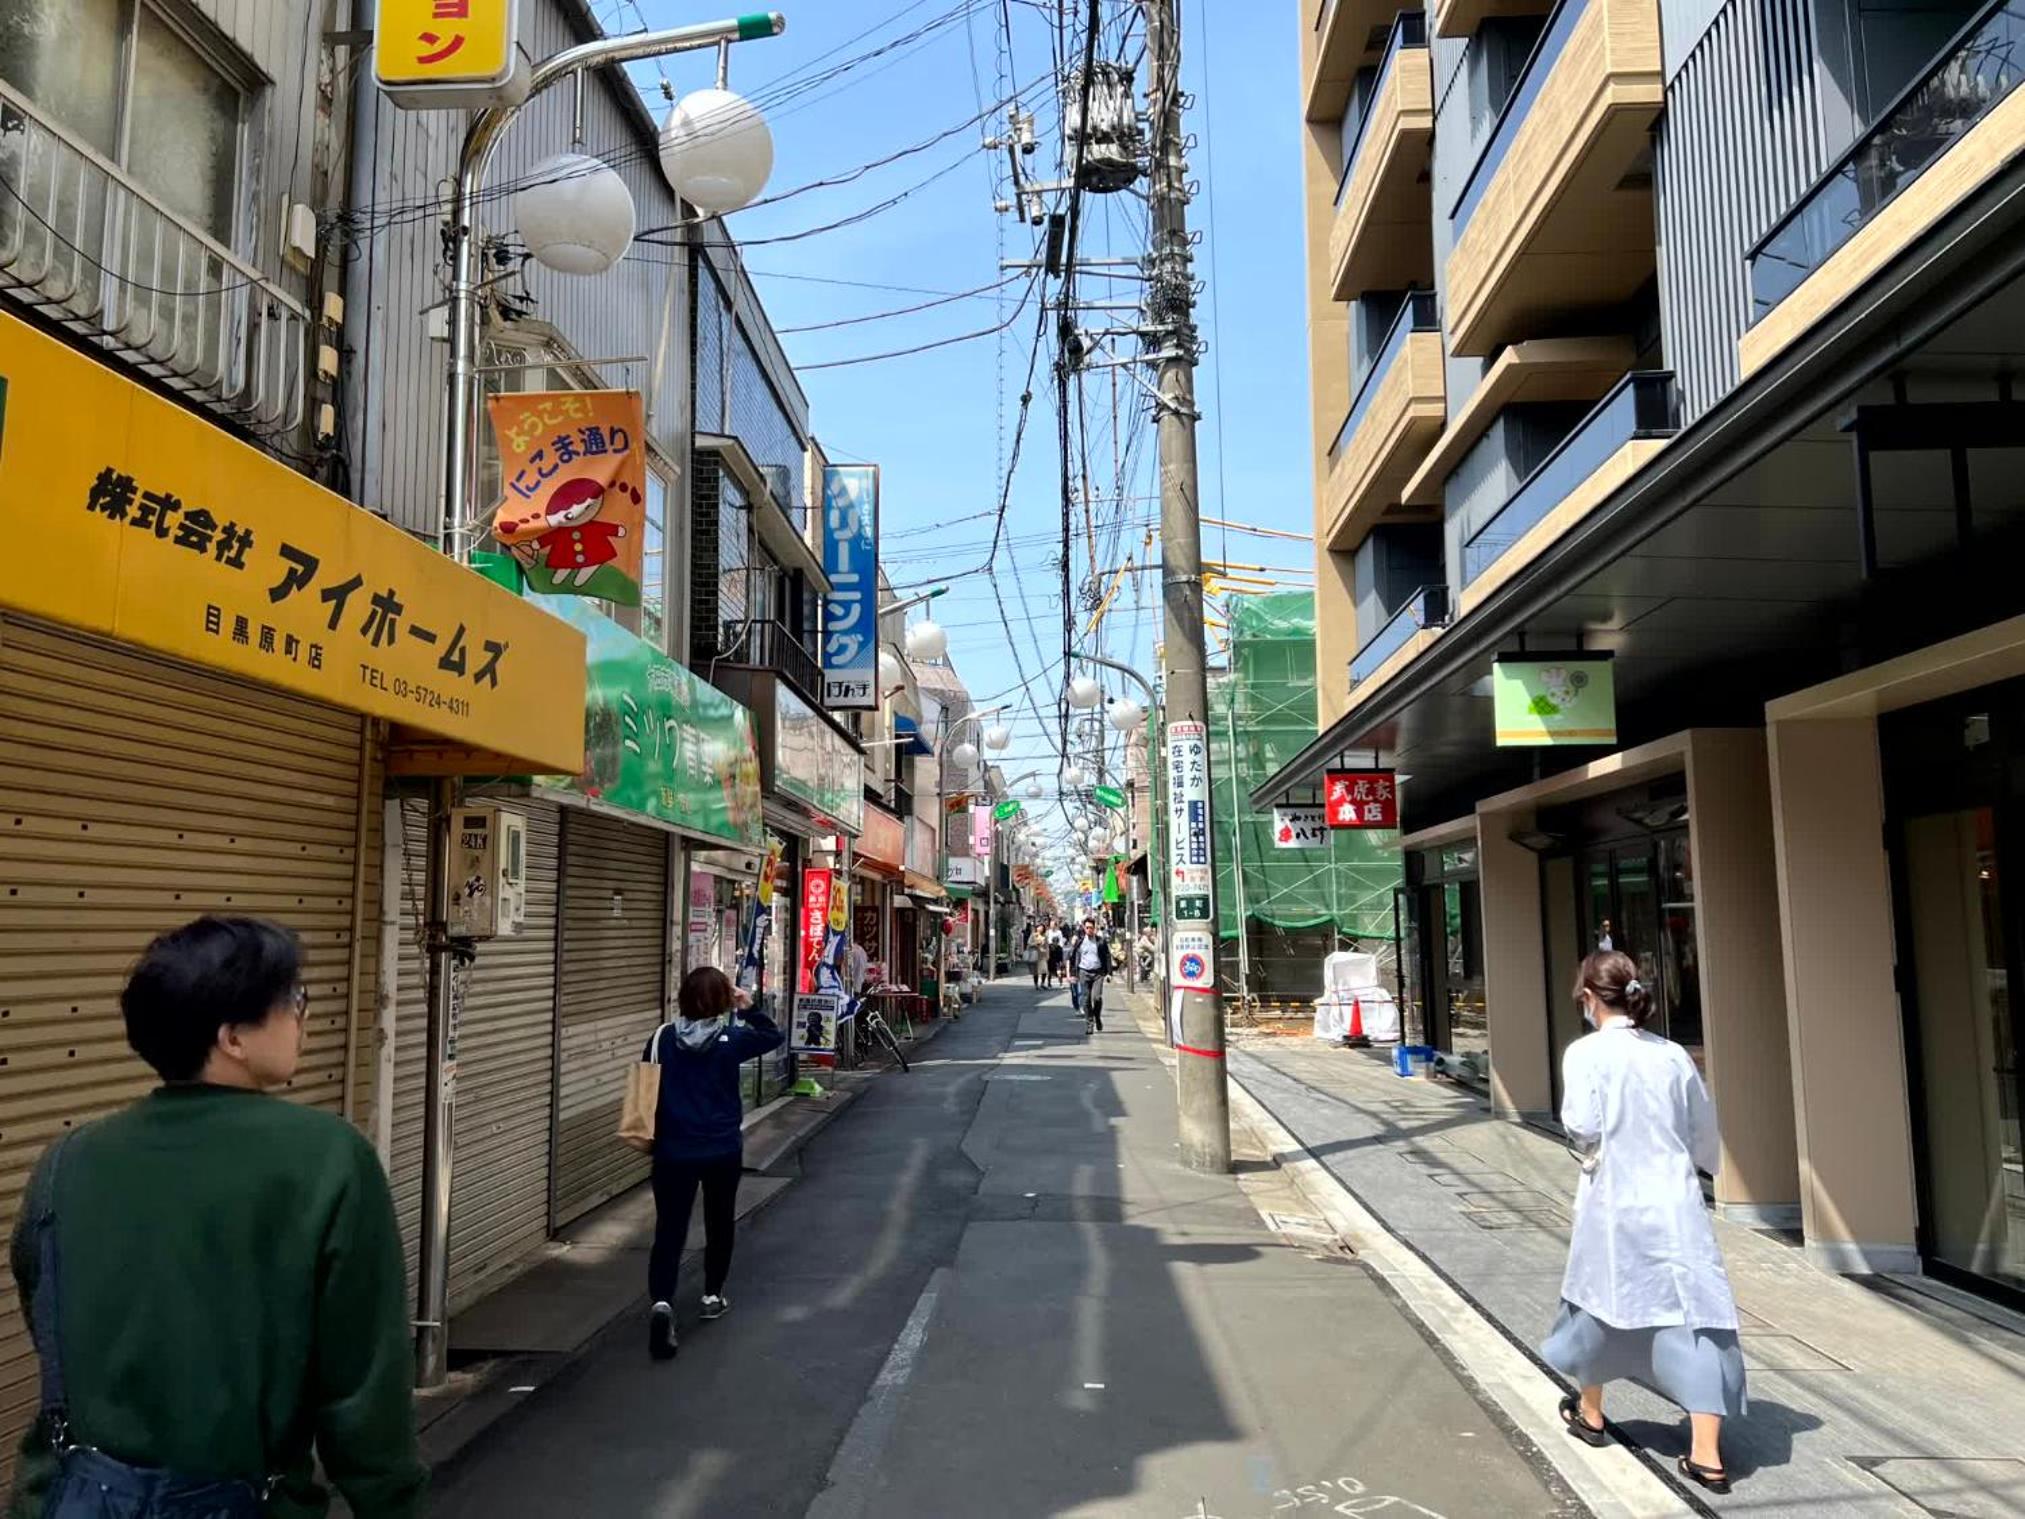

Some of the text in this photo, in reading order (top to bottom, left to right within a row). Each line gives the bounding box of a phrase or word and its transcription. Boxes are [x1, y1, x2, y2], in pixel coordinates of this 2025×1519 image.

[509, 425, 630, 500] にこま通り
[86, 466, 510, 690] 株式会社 アイホームズ
[825, 473, 863, 666] クリーニング
[204, 603, 324, 670] 目黒原町店
[360, 664, 470, 718] TEL 03-5724-4311
[1189, 743, 1204, 788] ゆたか
[1330, 780, 1393, 802] 武虎家
[1172, 744, 1187, 866] 在宅福祉サービス
[1337, 802, 1383, 822] 本店
